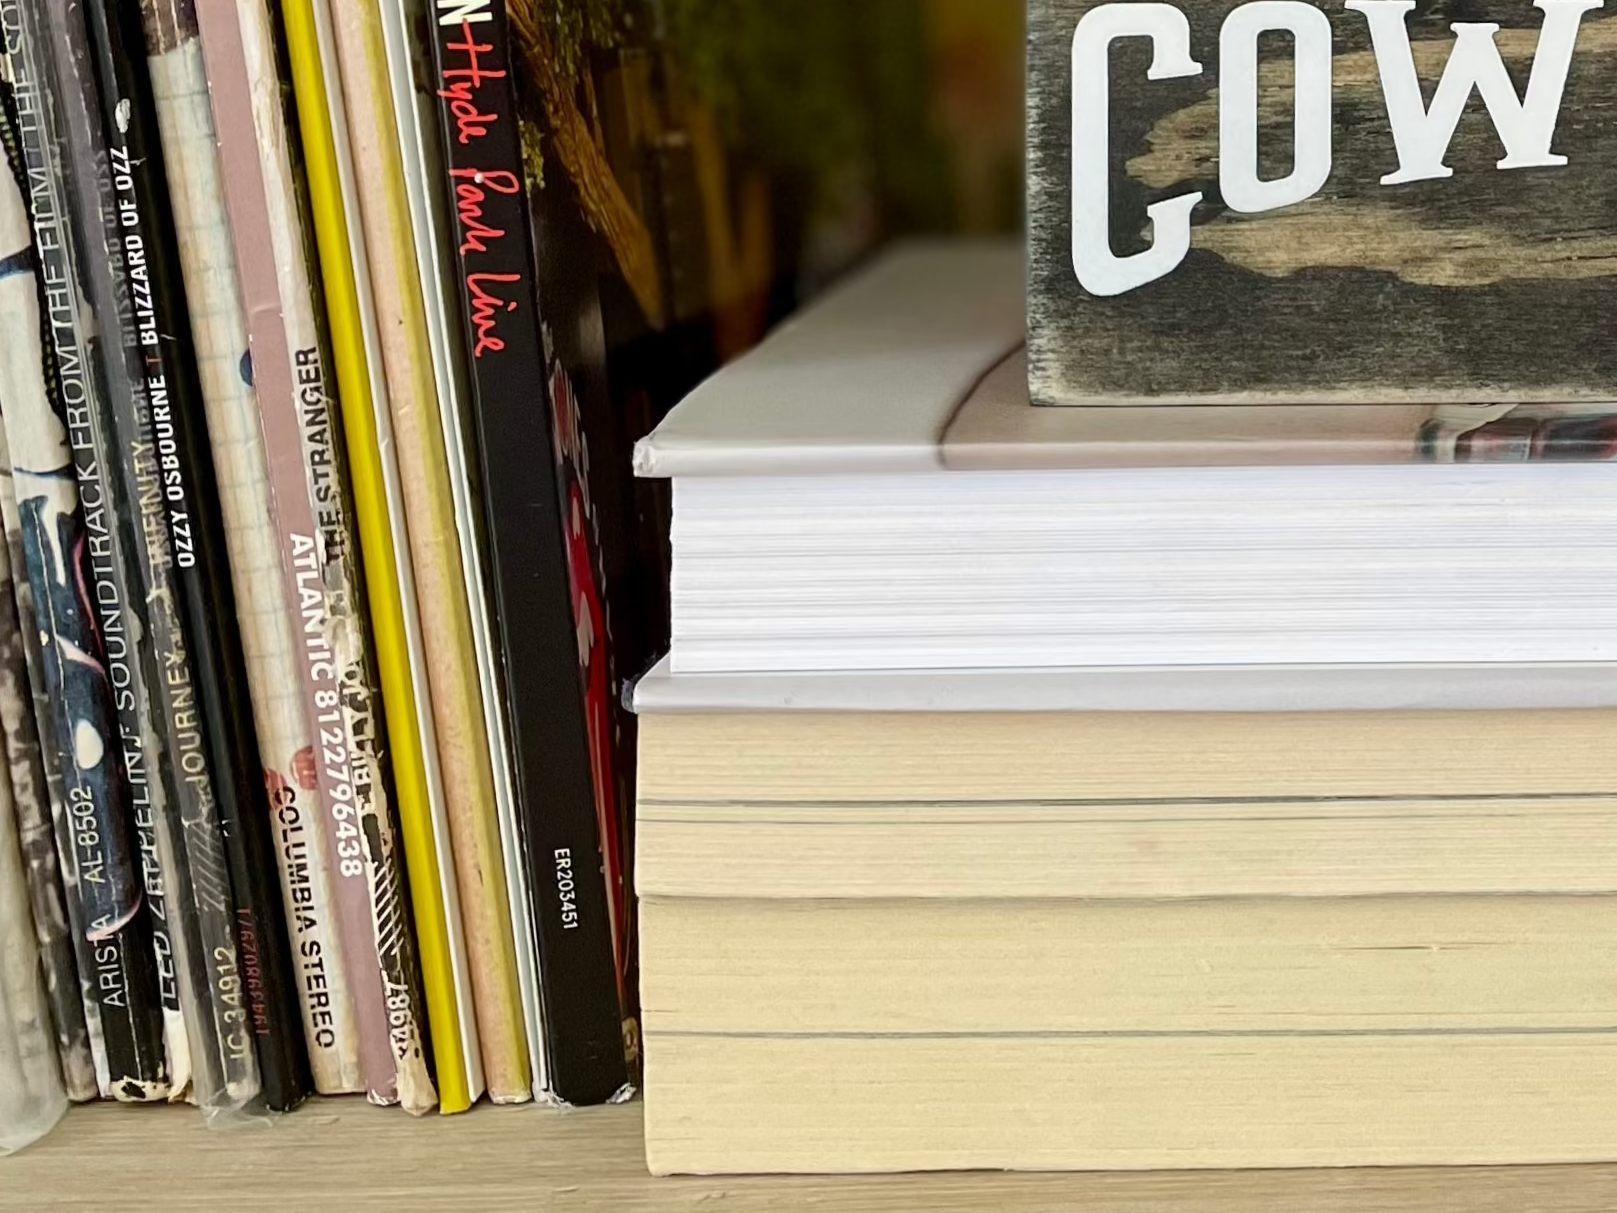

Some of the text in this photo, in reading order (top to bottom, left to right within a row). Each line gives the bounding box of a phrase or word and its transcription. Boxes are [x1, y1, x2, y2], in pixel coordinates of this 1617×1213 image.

[436, 18, 506, 145] Hyde
[109, 145, 133, 191] OZZ
[117, 198, 140, 227] OF
[448, 167, 520, 256] Park
[125, 234, 160, 346] BLIZZARD
[53, 340, 96, 452] FROM
[147, 374, 183, 502] OSBOURNE
[296, 347, 336, 503] STRANGER
[76, 459, 136, 712] SOUNDTRACK
[169, 509, 197, 569] OZZY
[166, 648, 206, 788] JOURNEY
[289, 531, 360, 878] ATLANTIC 8122796438
[275, 785, 336, 1050] COLUMBIA STEREO
[552, 847, 579, 931] ER203451
[87, 913, 125, 1008] ARISTA
[213, 945, 247, 1024] 34912
